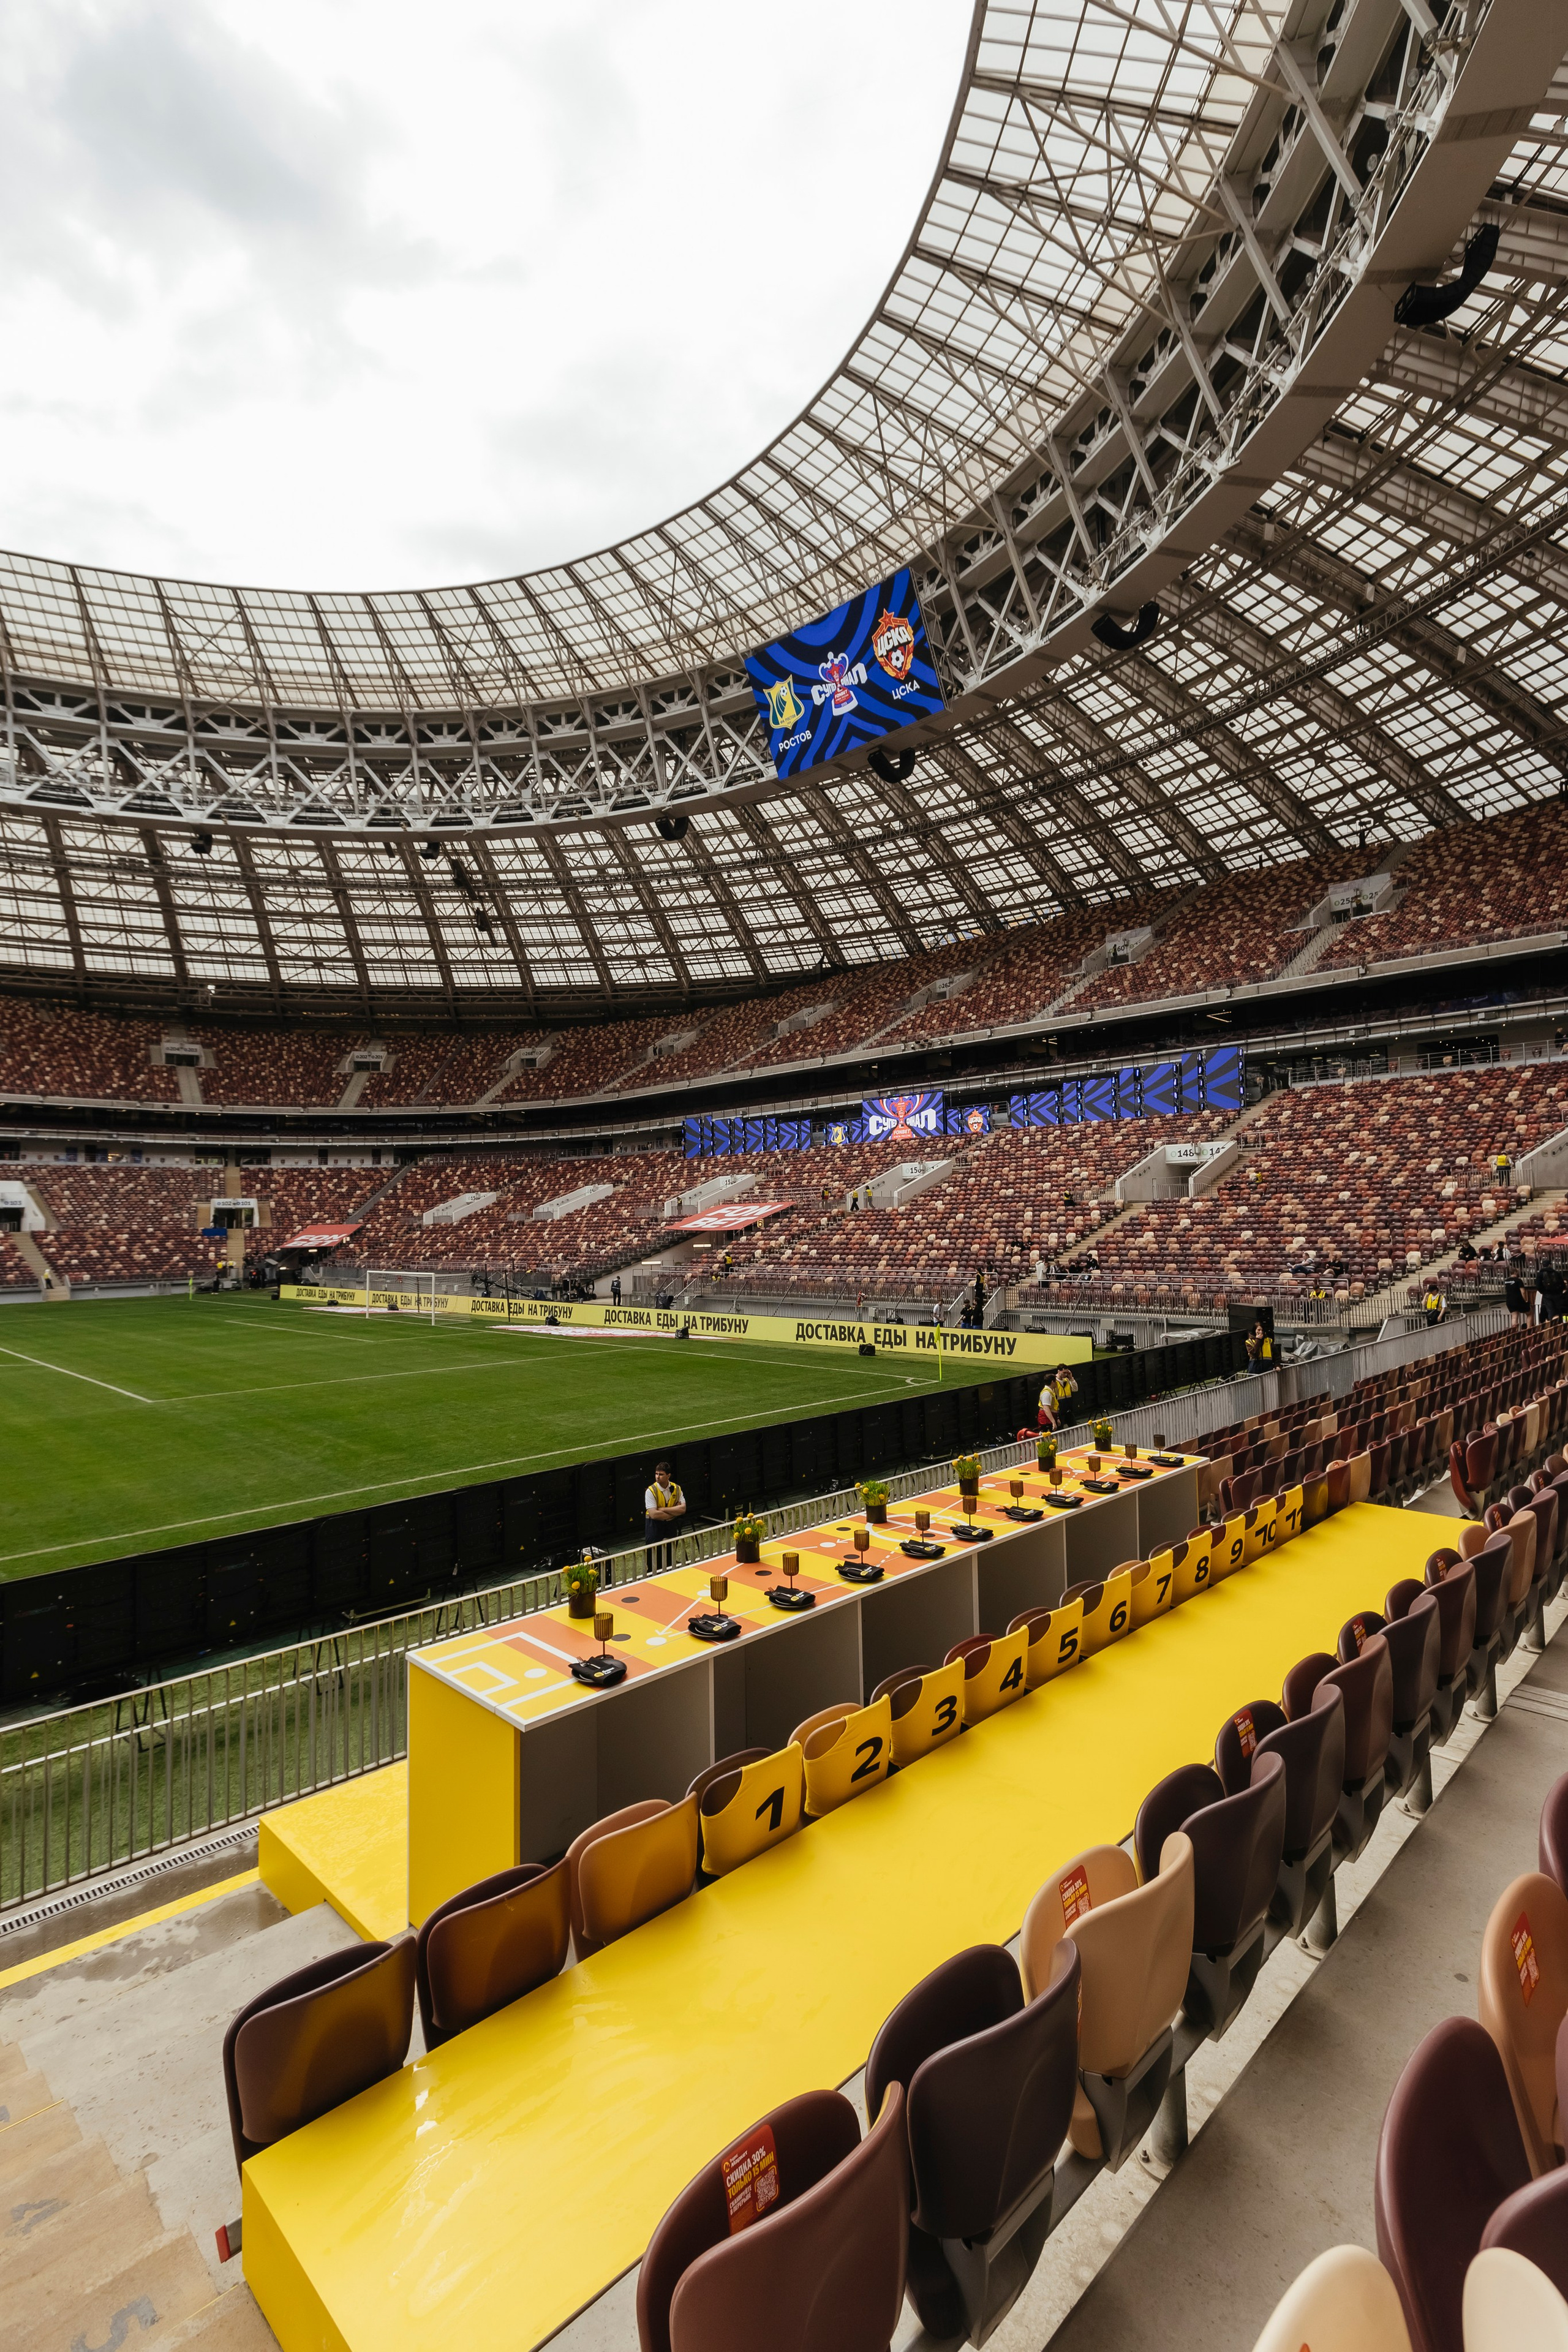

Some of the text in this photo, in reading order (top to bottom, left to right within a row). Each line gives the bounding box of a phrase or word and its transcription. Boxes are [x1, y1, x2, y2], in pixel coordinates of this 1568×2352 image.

[877, 626, 911, 657] ЦСКА
[892, 680, 920, 700] ЦСКА
[778, 730, 812, 752] РОСТОВ
[907, 1108, 936, 1131] ФИНАЛ
[679, 1216, 759, 1228] BET
[705, 1204, 784, 1216] FON
[296, 1287, 355, 1301] ДОСТАВКА ЕДЫ НА ТРИБУНУ
[372, 1293, 398, 1305] ДОСТАВКА
[401, 1295, 412, 1307] ЕДЫ
[423, 1297, 449, 1308] ТРИБУНУ
[471, 1299, 573, 1319] ДОСТАВКА ЕДЫ НА ТРИБУНУ
[605, 1309, 749, 1333] ДОСТАВКА ЕДЫ НА ТРИБУНУ
[796, 1322, 1017, 1355] ДОСТАВКА ЕДЫ НА ТРИБУНУ
[1255, 1519, 1276, 1547] 10
[1230, 1538, 1243, 1564] 9
[1194, 1556, 1210, 1583] 8
[1156, 1572, 1172, 1605] 7
[1109, 1600, 1127, 1633] 6
[1057, 1626, 1079, 1664] 5
[999, 1656, 1024, 1693] 4
[931, 1695, 957, 1736] 3
[851, 1736, 883, 1784] 2
[755, 1785, 785, 1832] 1
[726, 2145, 766, 2188] СКИДКА 30%
[728, 2151, 774, 2199] ТОЛЬКО 15 МИН
